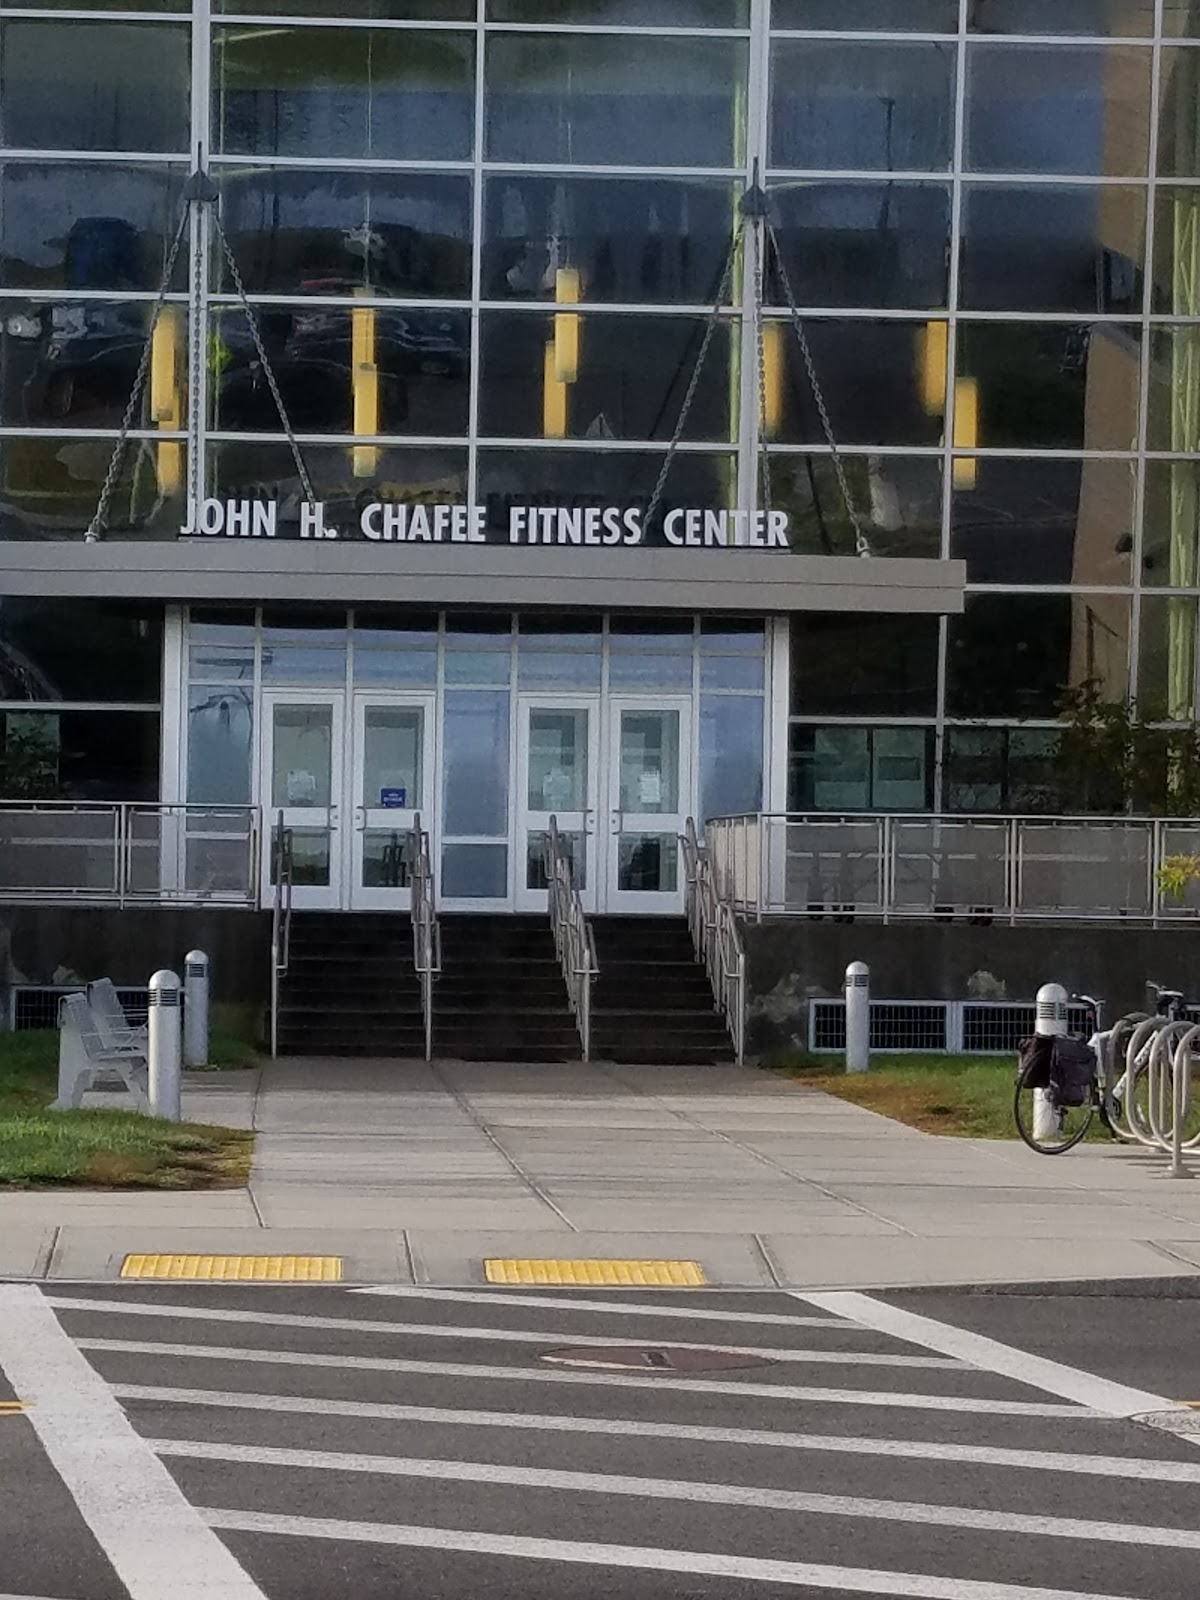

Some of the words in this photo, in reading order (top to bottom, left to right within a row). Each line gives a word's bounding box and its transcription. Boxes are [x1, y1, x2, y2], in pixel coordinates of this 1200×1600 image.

[181, 498, 277, 536] JOHN
[301, 501, 337, 539] H.
[361, 503, 487, 542] CHAFEE
[510, 506, 643, 545] FITNESS
[664, 508, 790, 547] CENTER
